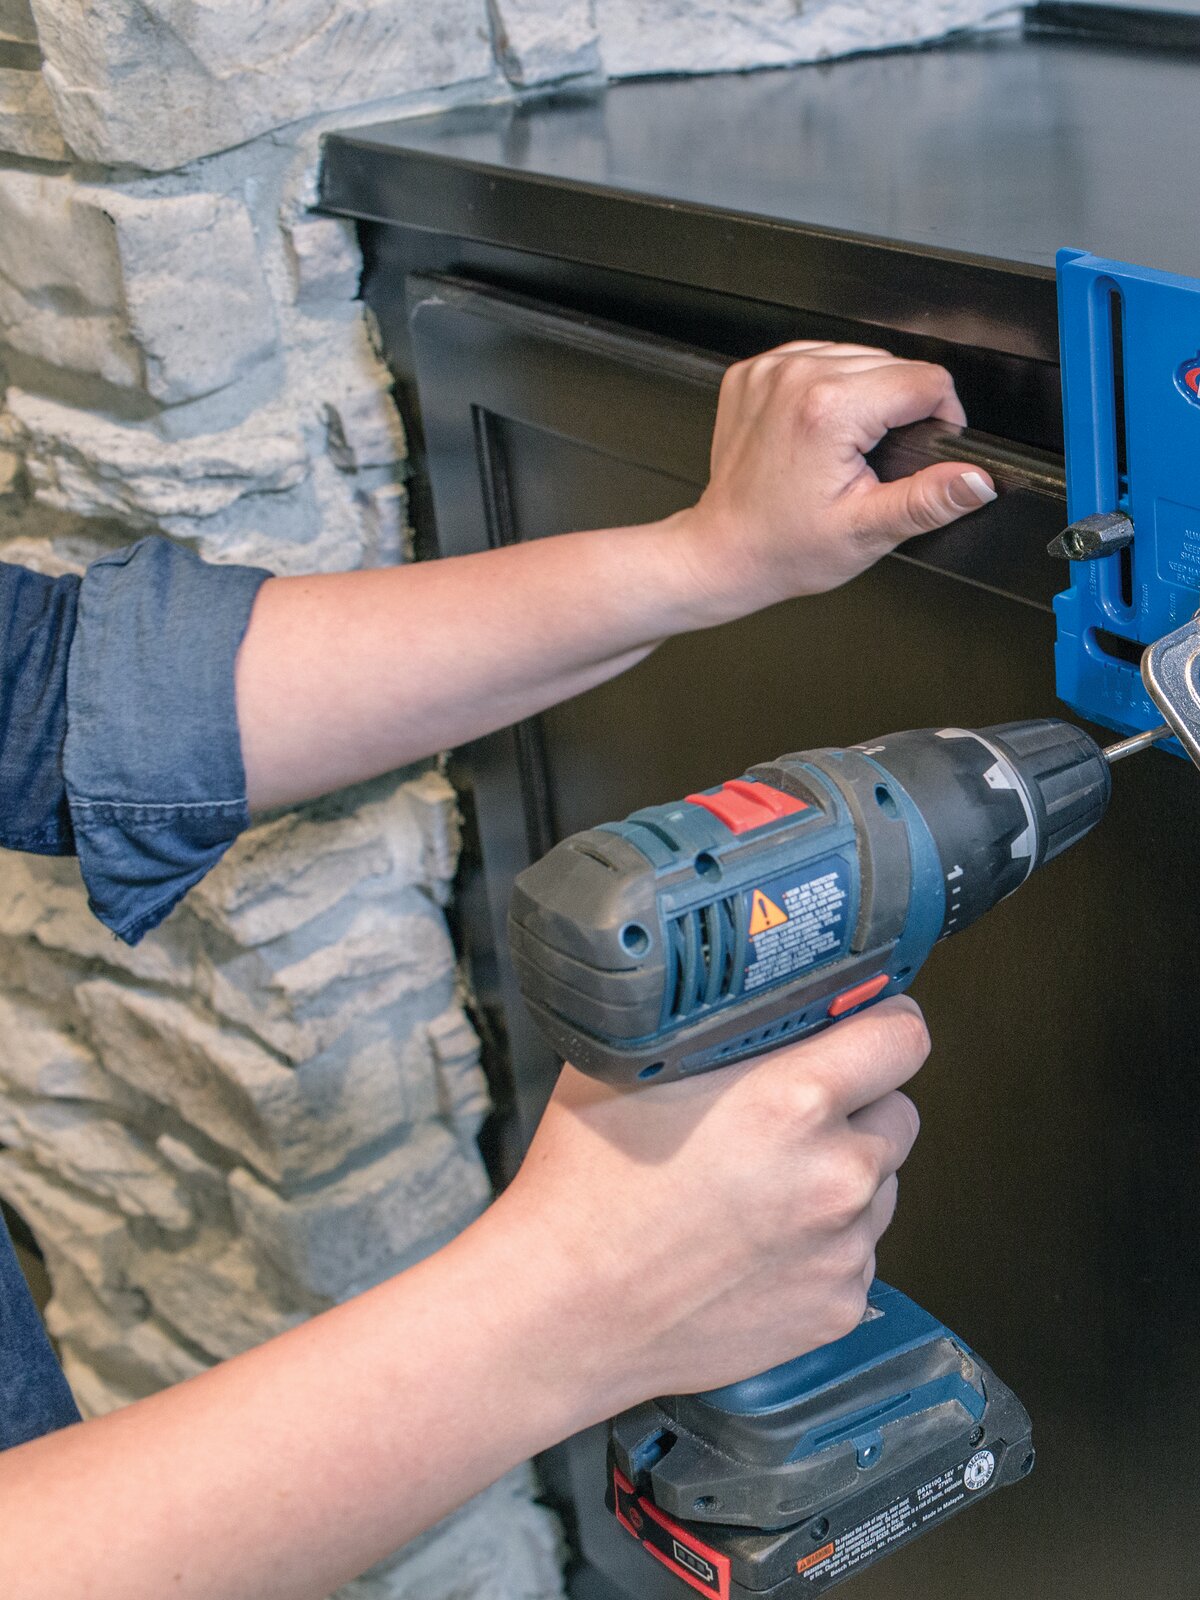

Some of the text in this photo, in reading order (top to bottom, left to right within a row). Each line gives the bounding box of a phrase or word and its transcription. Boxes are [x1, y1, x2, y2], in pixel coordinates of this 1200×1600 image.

[1183, 542, 1200, 555] KEEP
[1168, 560, 1187, 572] KEEP
[947, 865, 964, 881] 1
[944, 1468, 955, 1479] 18V
[830, 1564, 848, 1577] Bosch
[848, 1556, 859, 1566] Tool
[887, 1525, 911, 1543] Prospect,
[922, 1510, 936, 1522] Made
[942, 1493, 964, 1510] Malaysia
